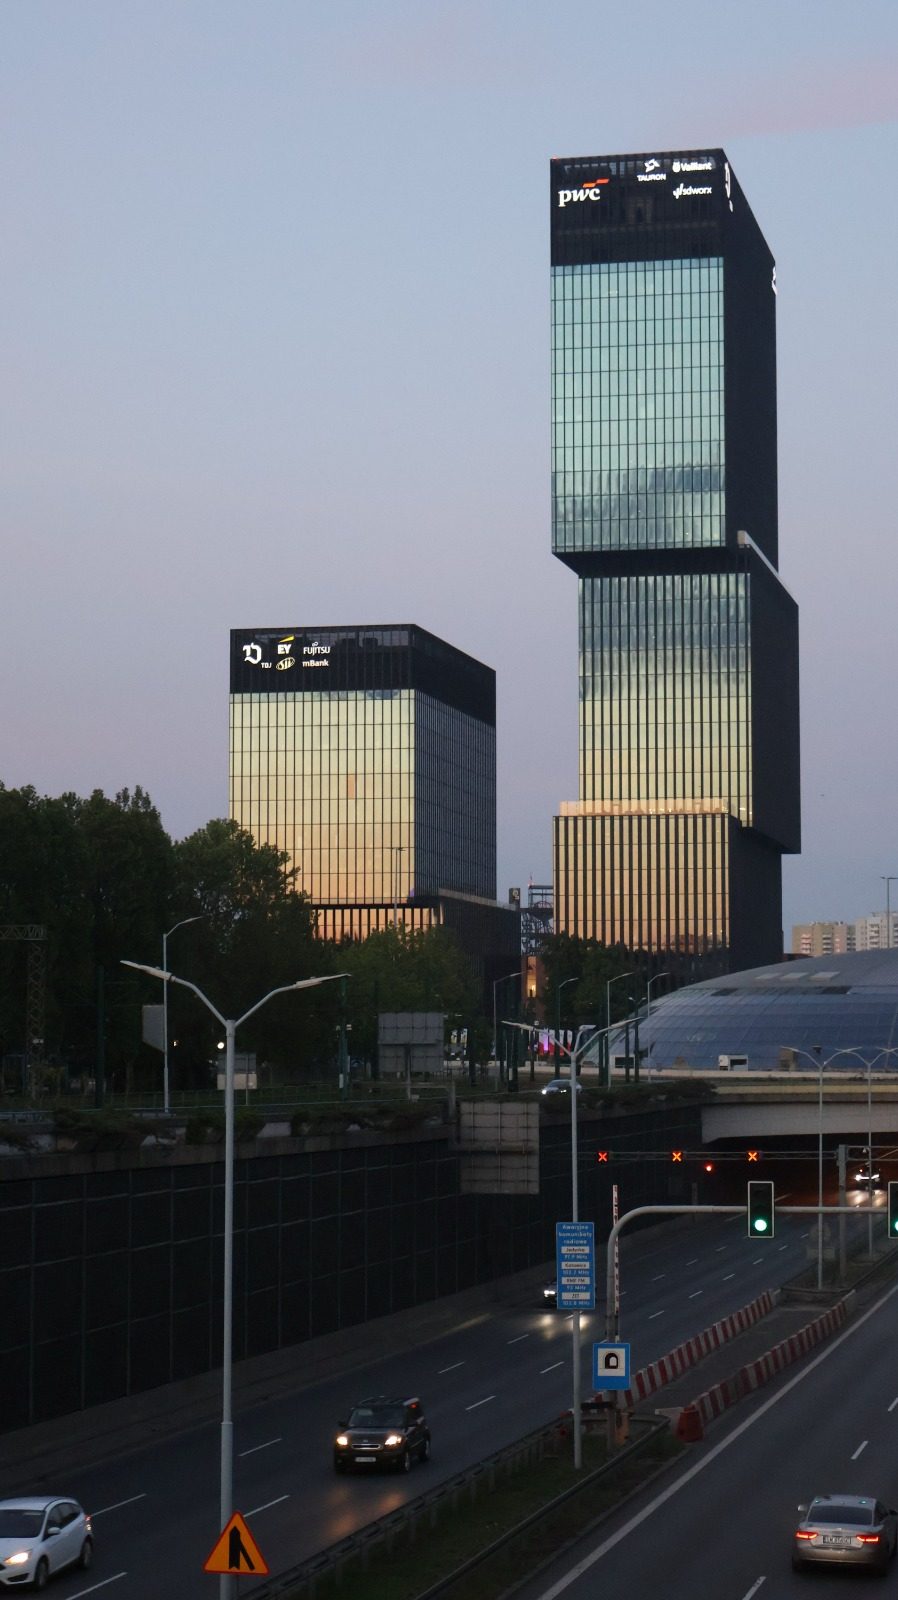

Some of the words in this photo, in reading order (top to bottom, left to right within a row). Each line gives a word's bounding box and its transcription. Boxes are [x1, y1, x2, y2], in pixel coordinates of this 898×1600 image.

[681, 162, 712, 171] Vaillant
[637, 173, 667, 182] TAURON
[558, 187, 601, 207] pwc
[277, 644, 291, 654] EY
[303, 646, 331, 656] FUJITSU
[302, 659, 329, 668] mBank
